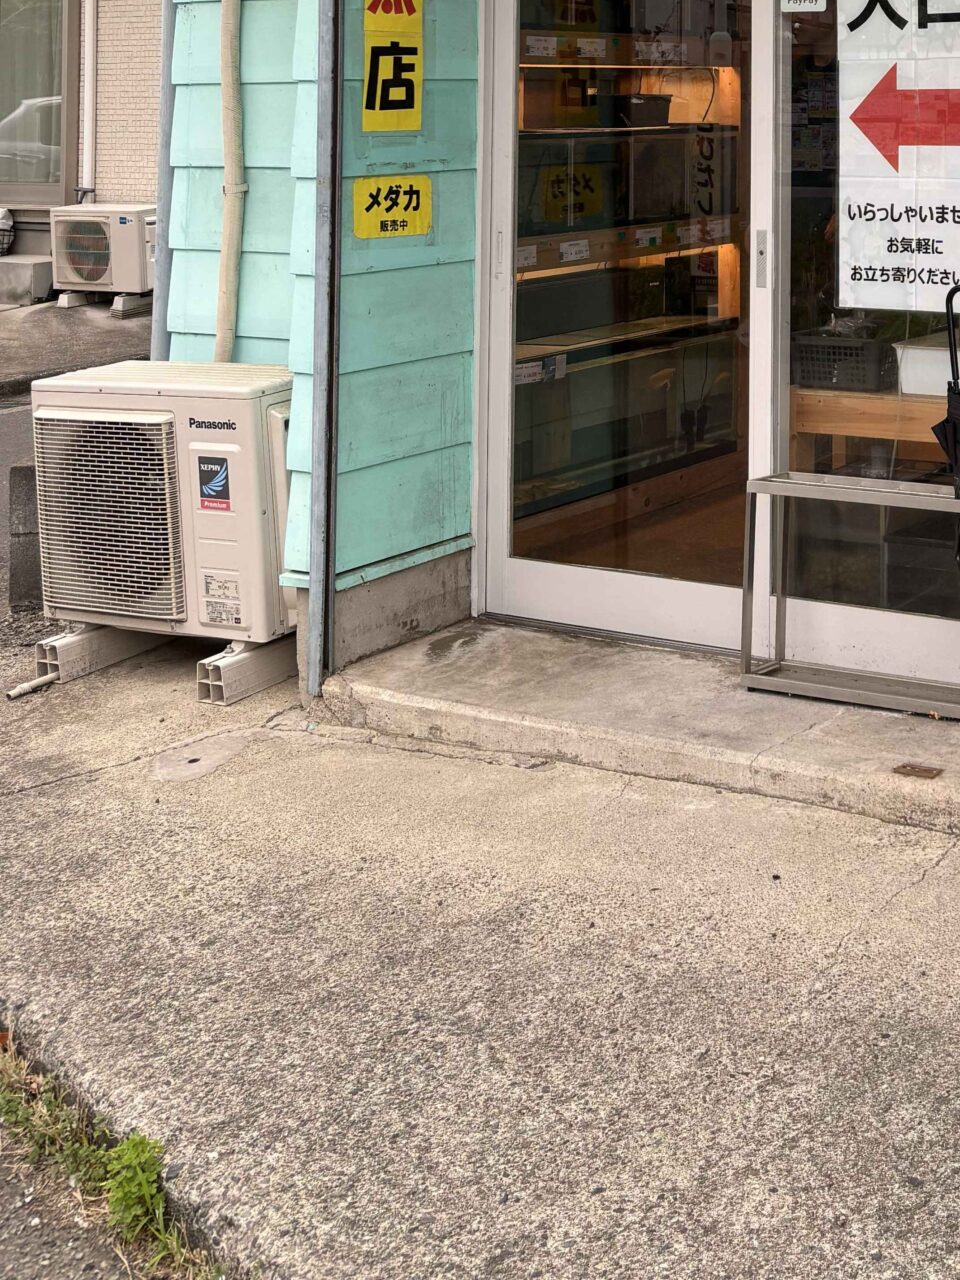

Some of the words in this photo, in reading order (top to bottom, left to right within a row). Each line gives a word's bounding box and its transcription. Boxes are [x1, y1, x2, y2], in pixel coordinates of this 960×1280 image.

[365, 184, 420, 213] メダカ
[380, 219, 408, 232] 販売中
[887, 237, 943, 254] お気軽に
[189, 418, 237, 431] Panasonic
